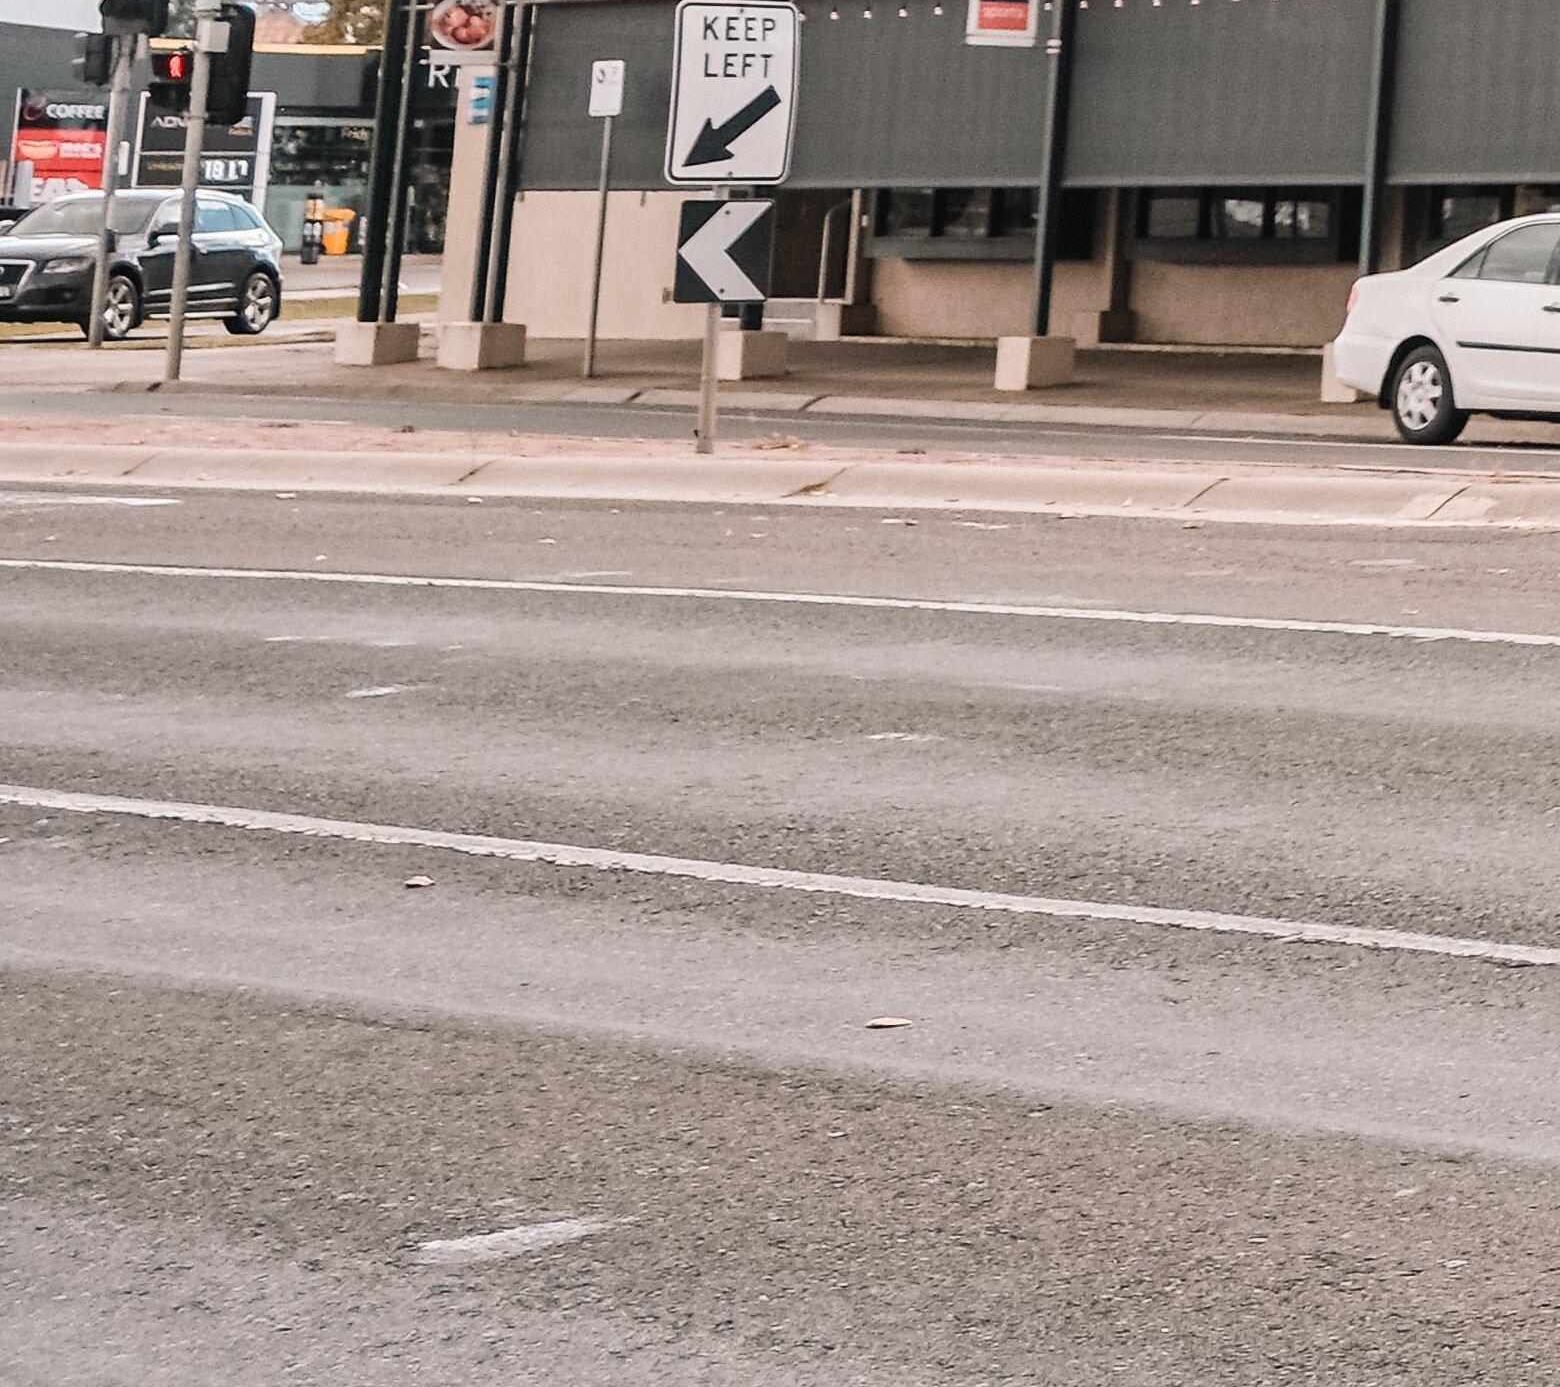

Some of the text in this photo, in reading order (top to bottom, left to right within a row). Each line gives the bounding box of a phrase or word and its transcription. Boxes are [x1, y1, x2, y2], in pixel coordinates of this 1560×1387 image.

[702, 15, 777, 43] KEEP
[703, 52, 775, 78] LEFT
[46, 103, 104, 120] COFFEE
